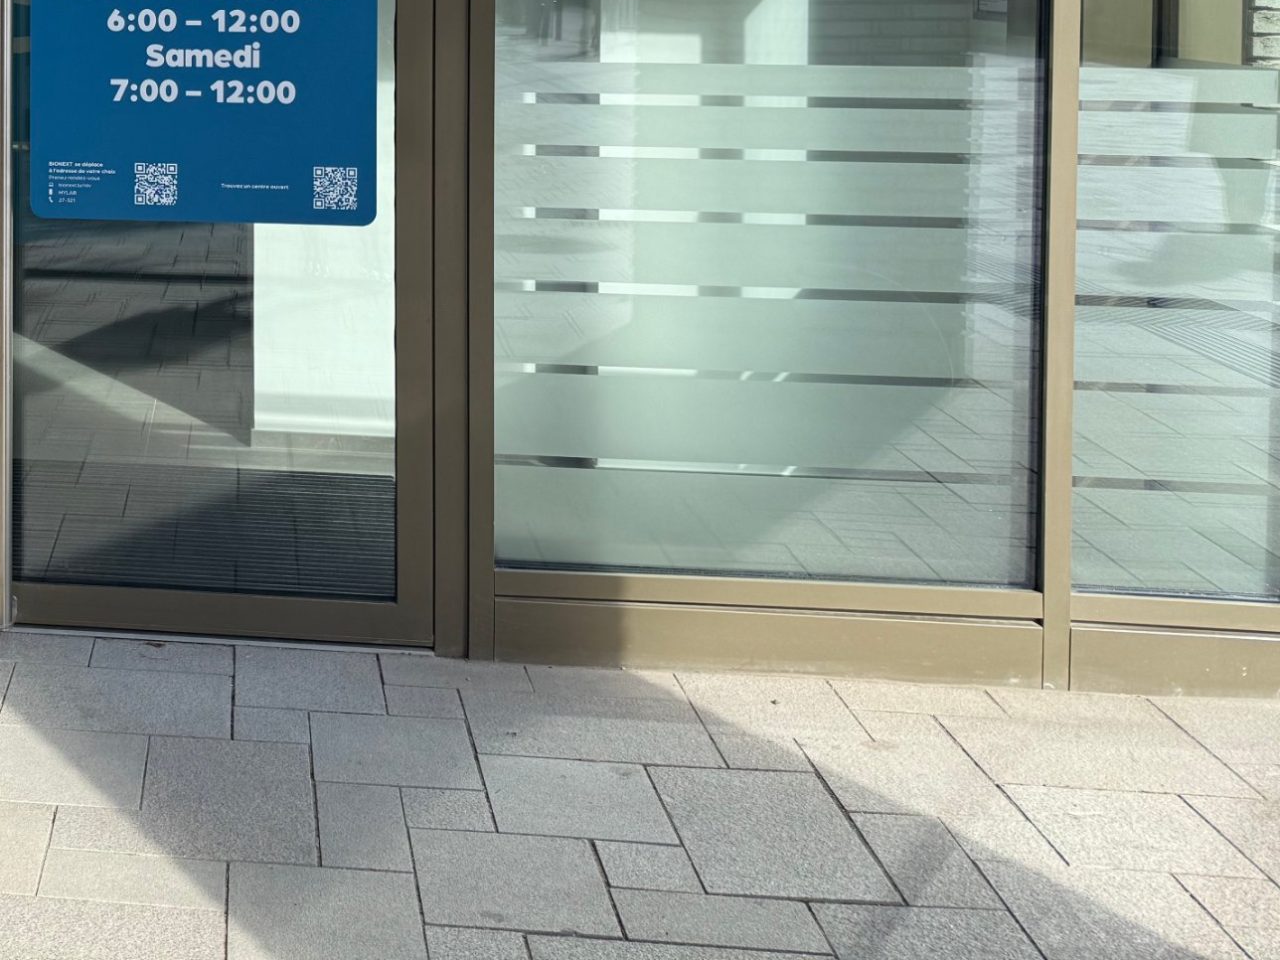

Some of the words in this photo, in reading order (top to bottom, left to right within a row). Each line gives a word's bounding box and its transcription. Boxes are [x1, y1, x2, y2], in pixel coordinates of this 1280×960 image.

[107, 8, 177, 32] 6:00
[211, 9, 300, 33] 12:00
[145, 41, 260, 68] Samedi
[110, 78, 179, 103] 7:00
[210, 80, 296, 104] 12:00
